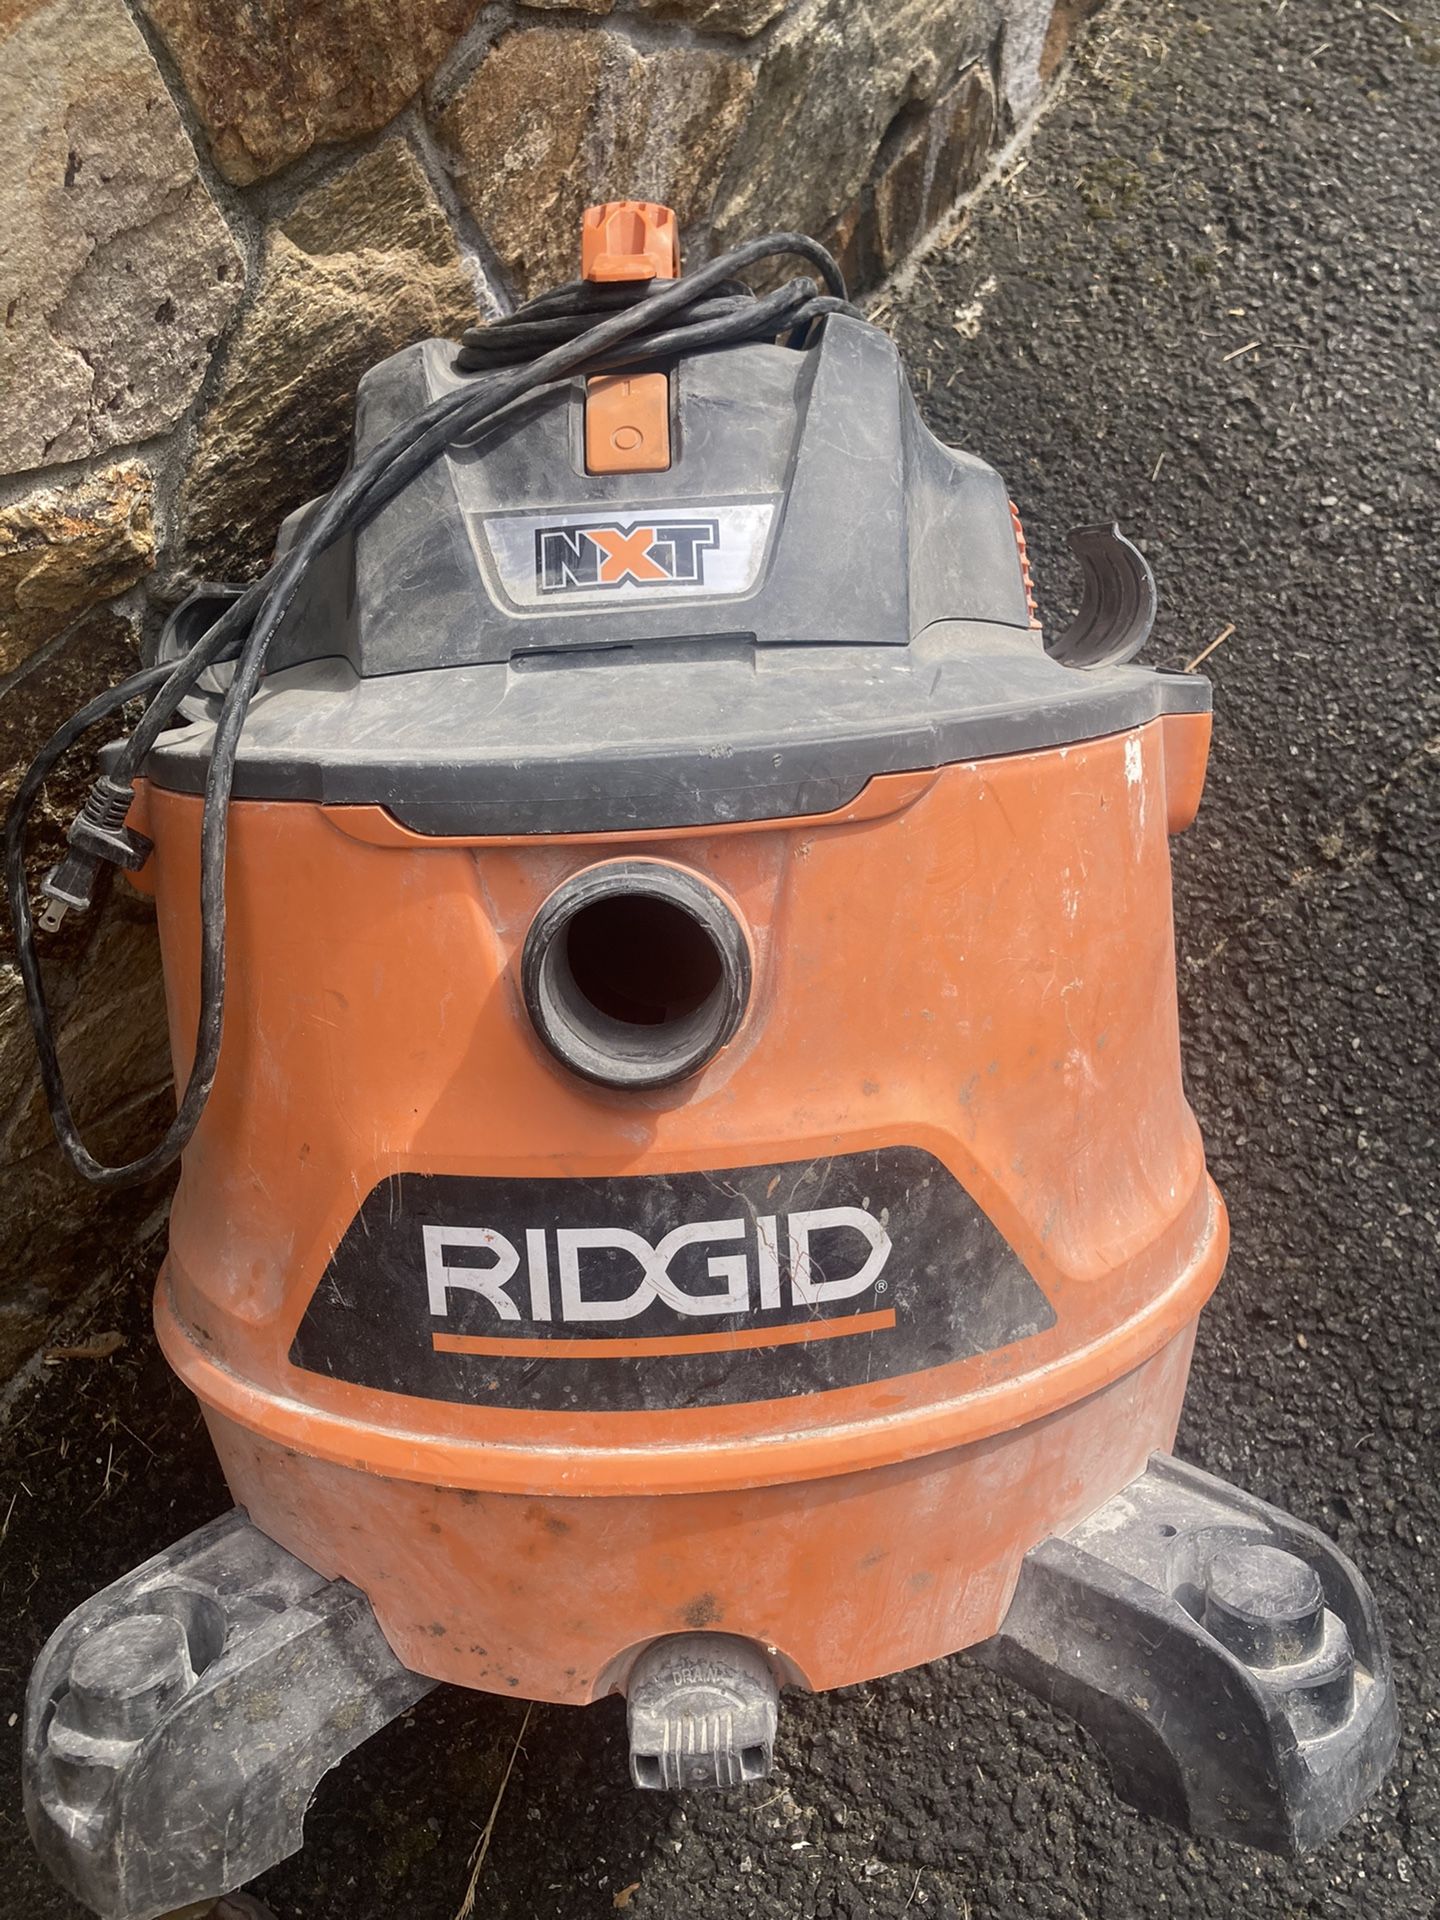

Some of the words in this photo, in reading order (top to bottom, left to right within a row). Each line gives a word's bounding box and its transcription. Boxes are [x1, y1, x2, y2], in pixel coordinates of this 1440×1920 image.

[536, 519, 719, 595] NXT
[422, 1206, 893, 1321] RIDGID
[672, 1664, 718, 1687] DRAIN
